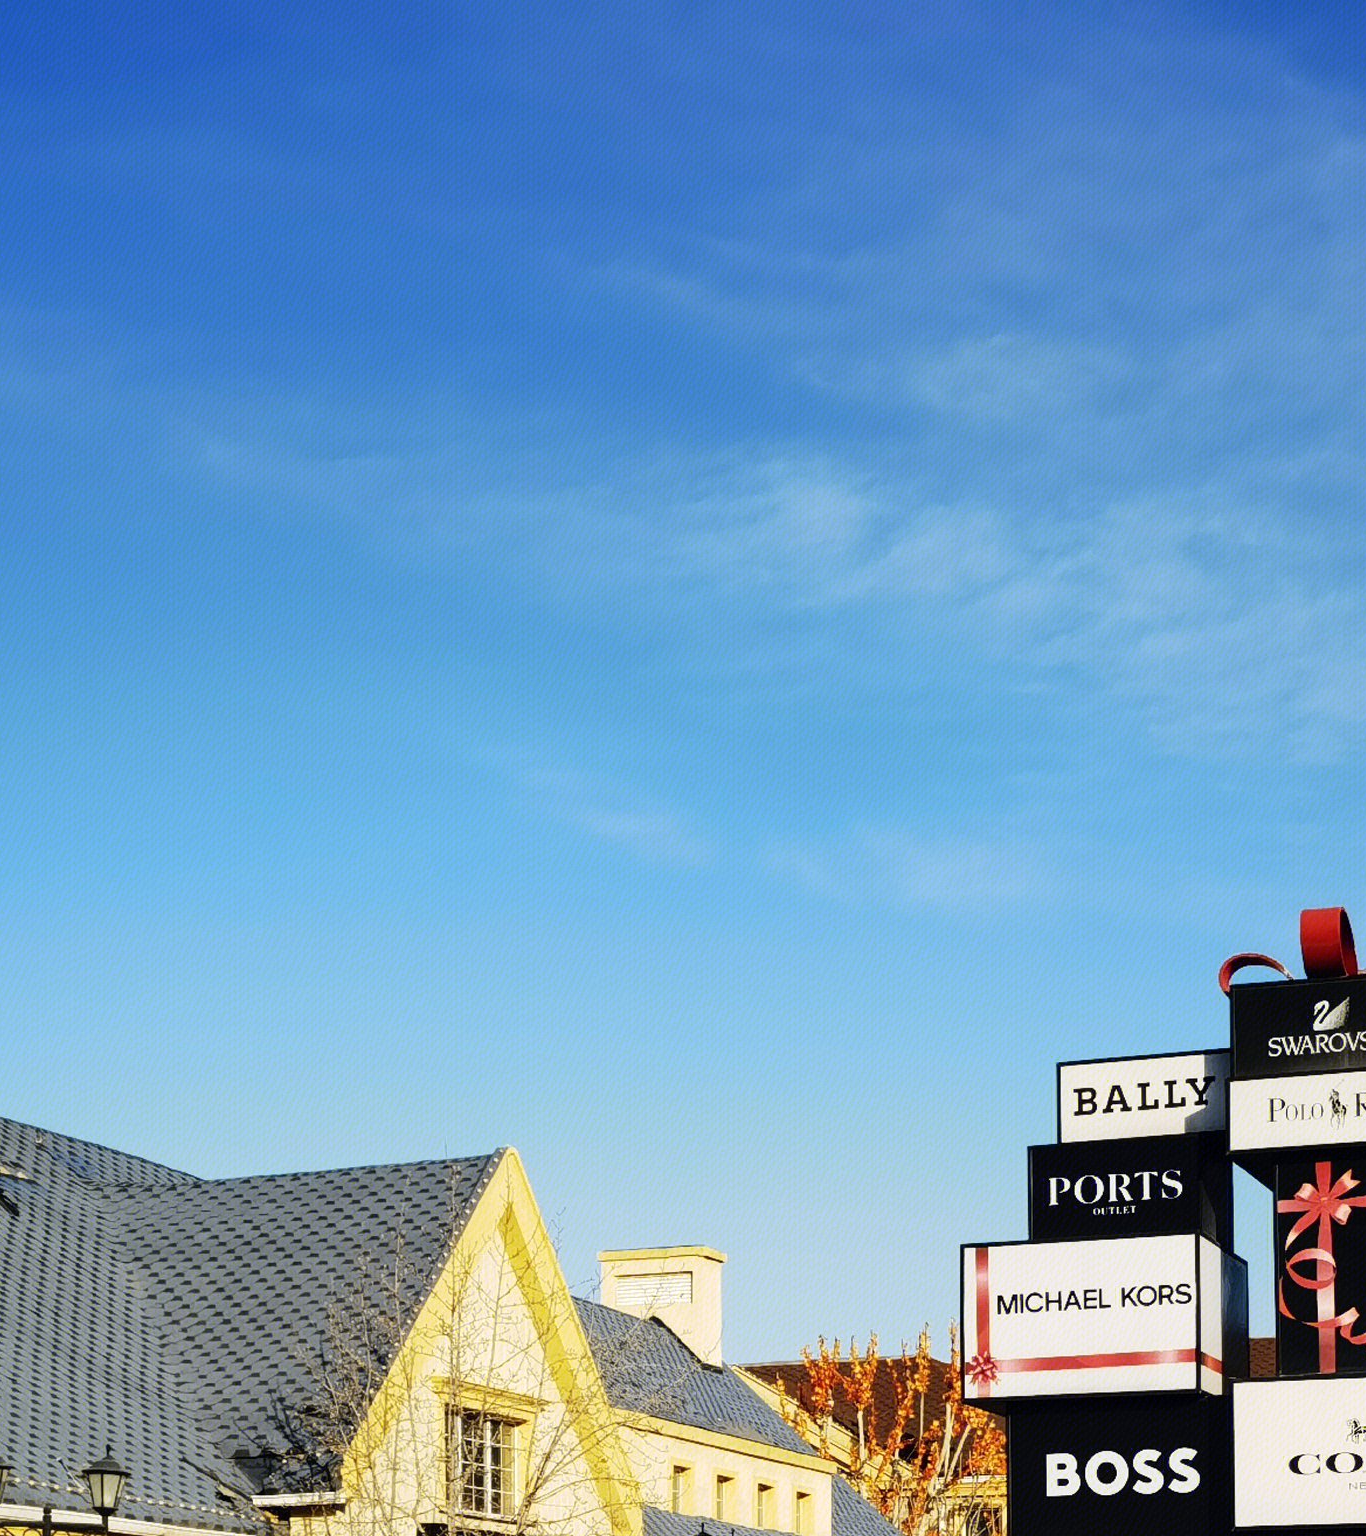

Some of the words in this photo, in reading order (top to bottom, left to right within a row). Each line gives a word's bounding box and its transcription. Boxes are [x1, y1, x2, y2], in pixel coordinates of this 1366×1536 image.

[1073, 1076, 1216, 1117] BALLY
[1267, 1097, 1325, 1124] POLO
[1048, 1169, 1184, 1207] PORTS
[1092, 1205, 1138, 1216] OUTLET
[996, 1288, 1112, 1315] MICHAEL
[1121, 1283, 1193, 1308] KORS
[1045, 1446, 1202, 1498] BOSS
